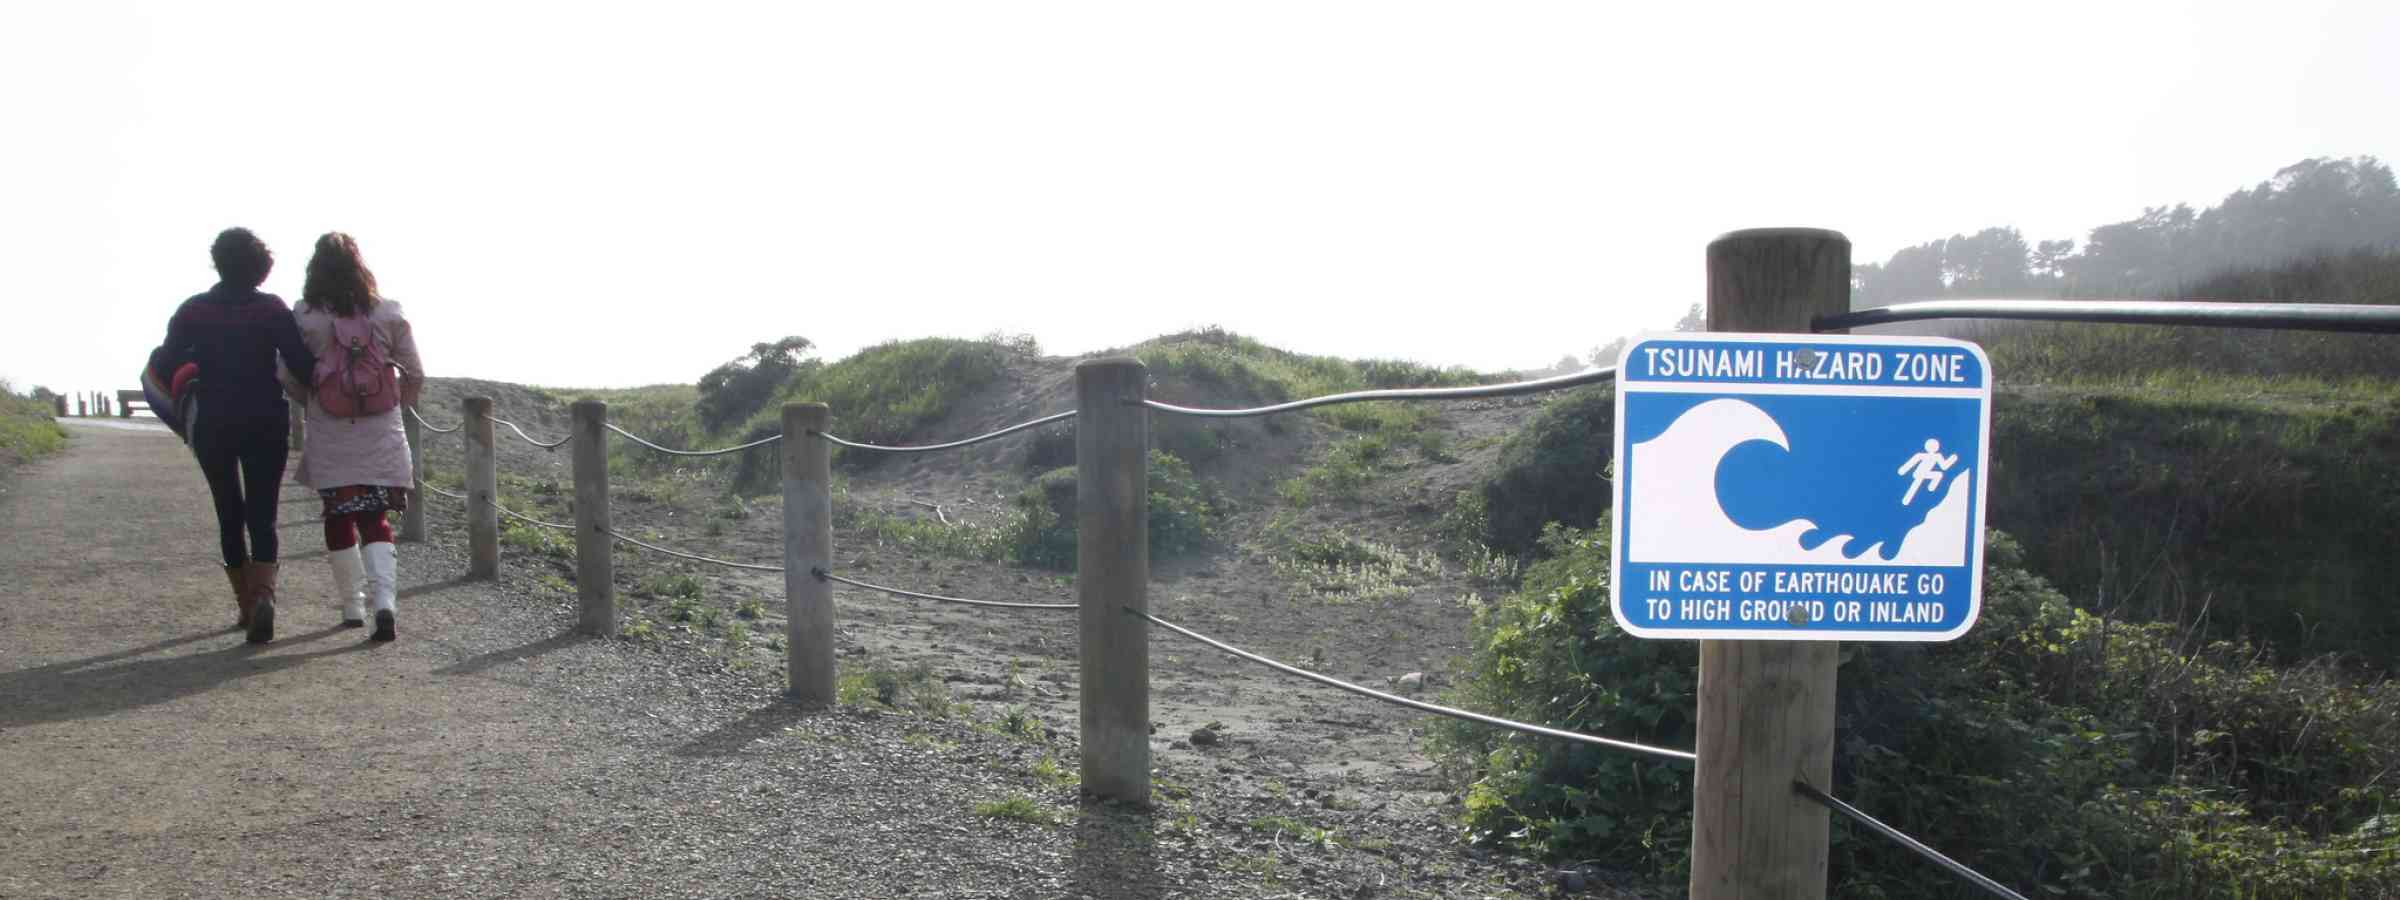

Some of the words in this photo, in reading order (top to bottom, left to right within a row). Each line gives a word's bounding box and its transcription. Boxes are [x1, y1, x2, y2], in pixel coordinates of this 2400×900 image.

[1644, 347, 1764, 378] TSUNAMI
[1893, 353, 1965, 383] ZONE
[1649, 569, 1671, 592] IN
[1679, 570, 1731, 593] CASE
[1739, 570, 1767, 593] OF
[1774, 571, 1909, 595] EARTHQUAKE
[1917, 573, 1945, 595] GO
[1646, 598, 1672, 621] TO
[1680, 599, 1731, 621] HIGH
[1833, 600, 1861, 623] OR
[1869, 601, 1945, 624] INLAND
